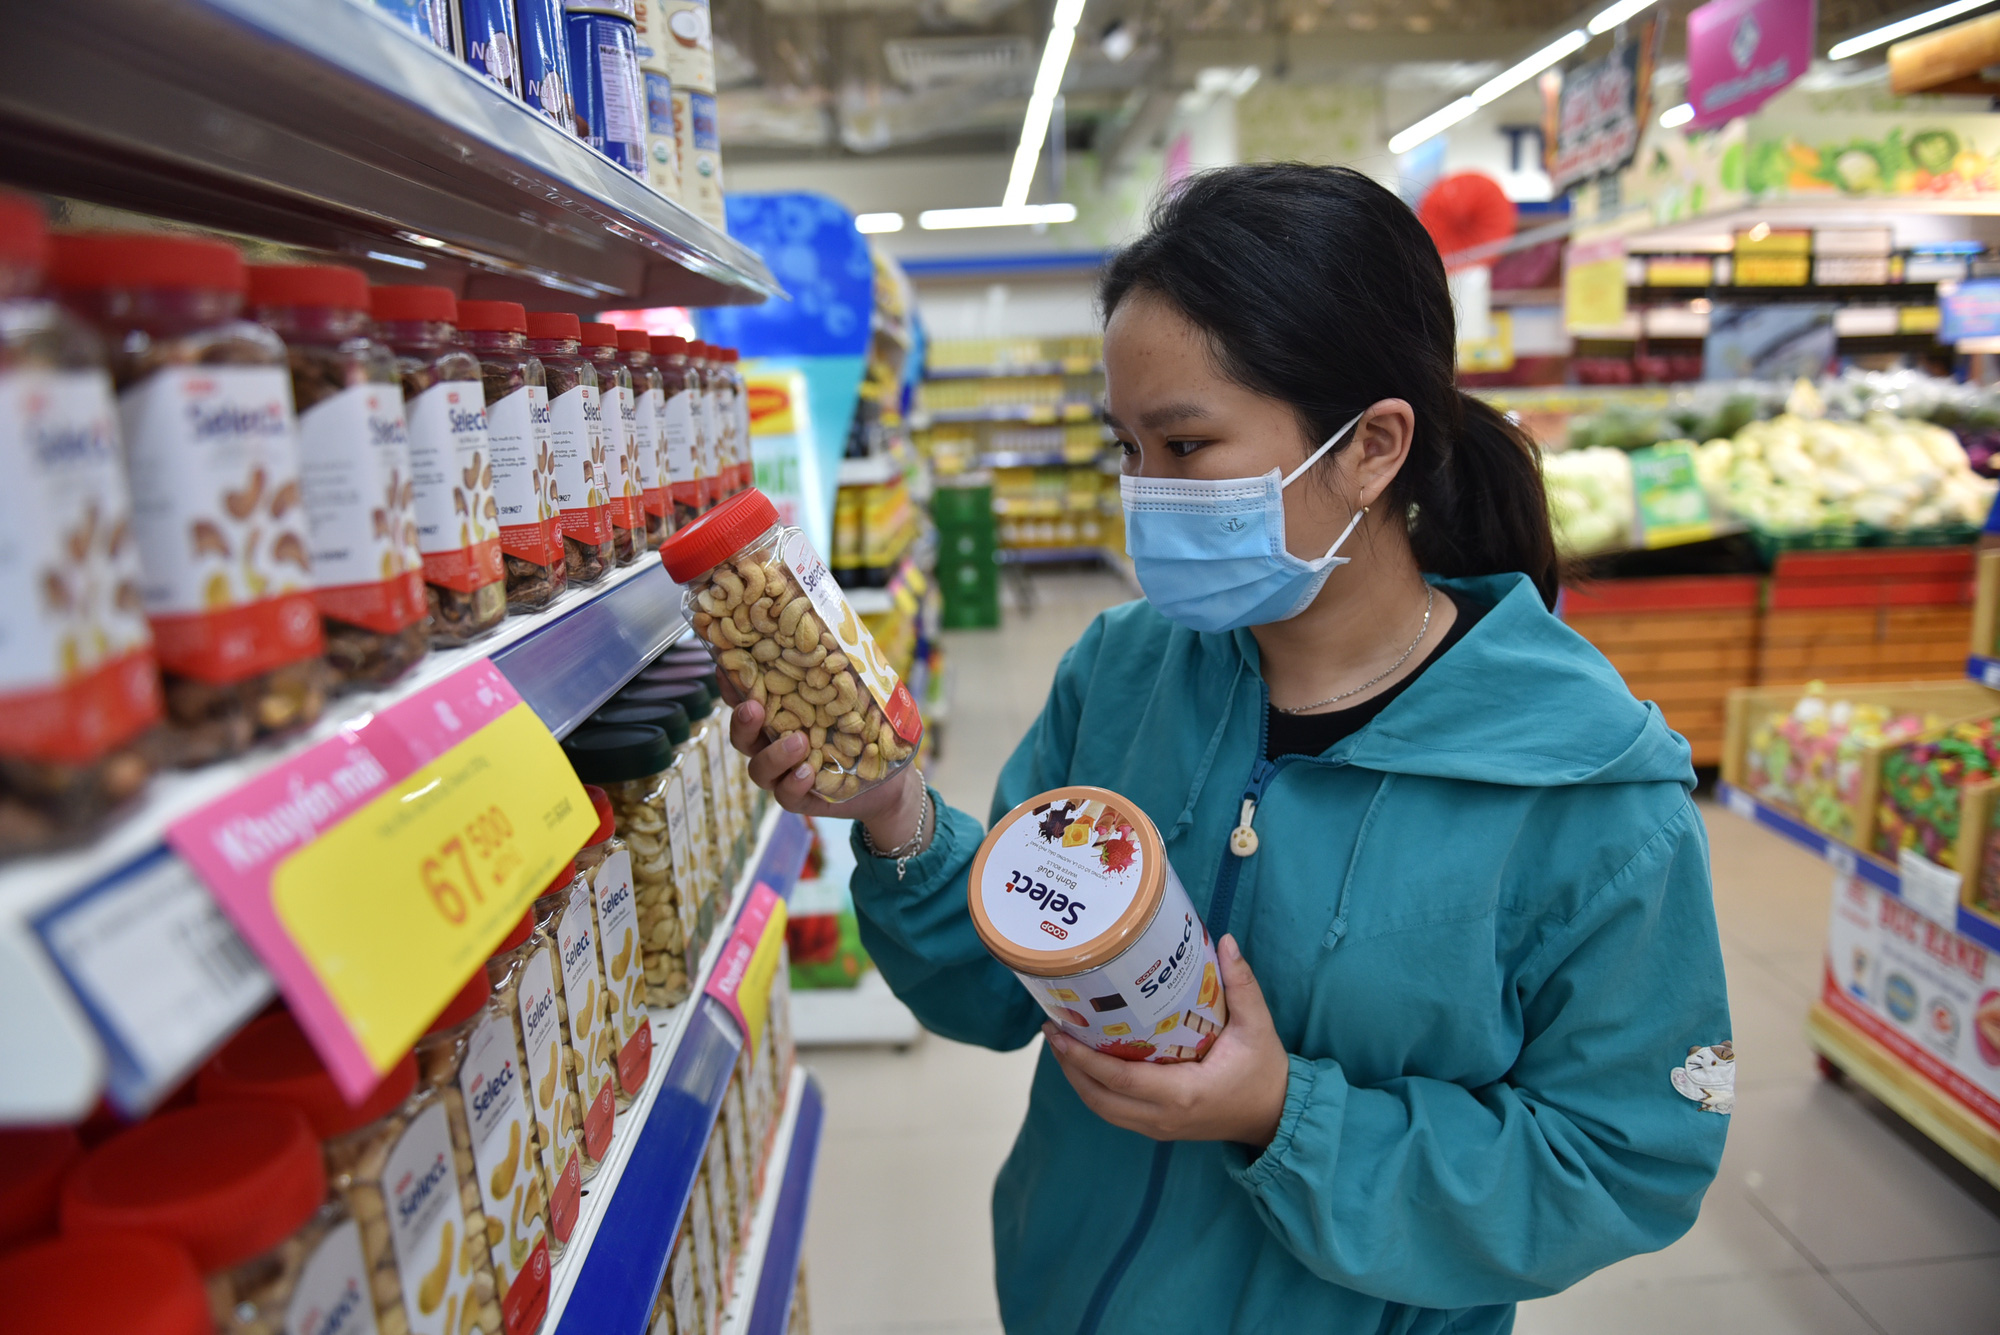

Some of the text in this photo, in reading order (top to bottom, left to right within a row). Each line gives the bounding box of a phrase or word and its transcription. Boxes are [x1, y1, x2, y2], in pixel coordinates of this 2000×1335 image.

[450, 408, 488, 433] Select
[420, 836, 485, 926] 67
[1005, 870, 1086, 925] Select
[1035, 865, 1077, 890] Bánh Quế
[601, 882, 629, 920] Select
[565, 930, 590, 973] Select
[1041, 921, 1067, 939] COOP
[1136, 960, 1161, 985] COOP
[1140, 912, 1192, 999] Select
[527, 987, 553, 1037] Select
[473, 1060, 514, 1123] Select
